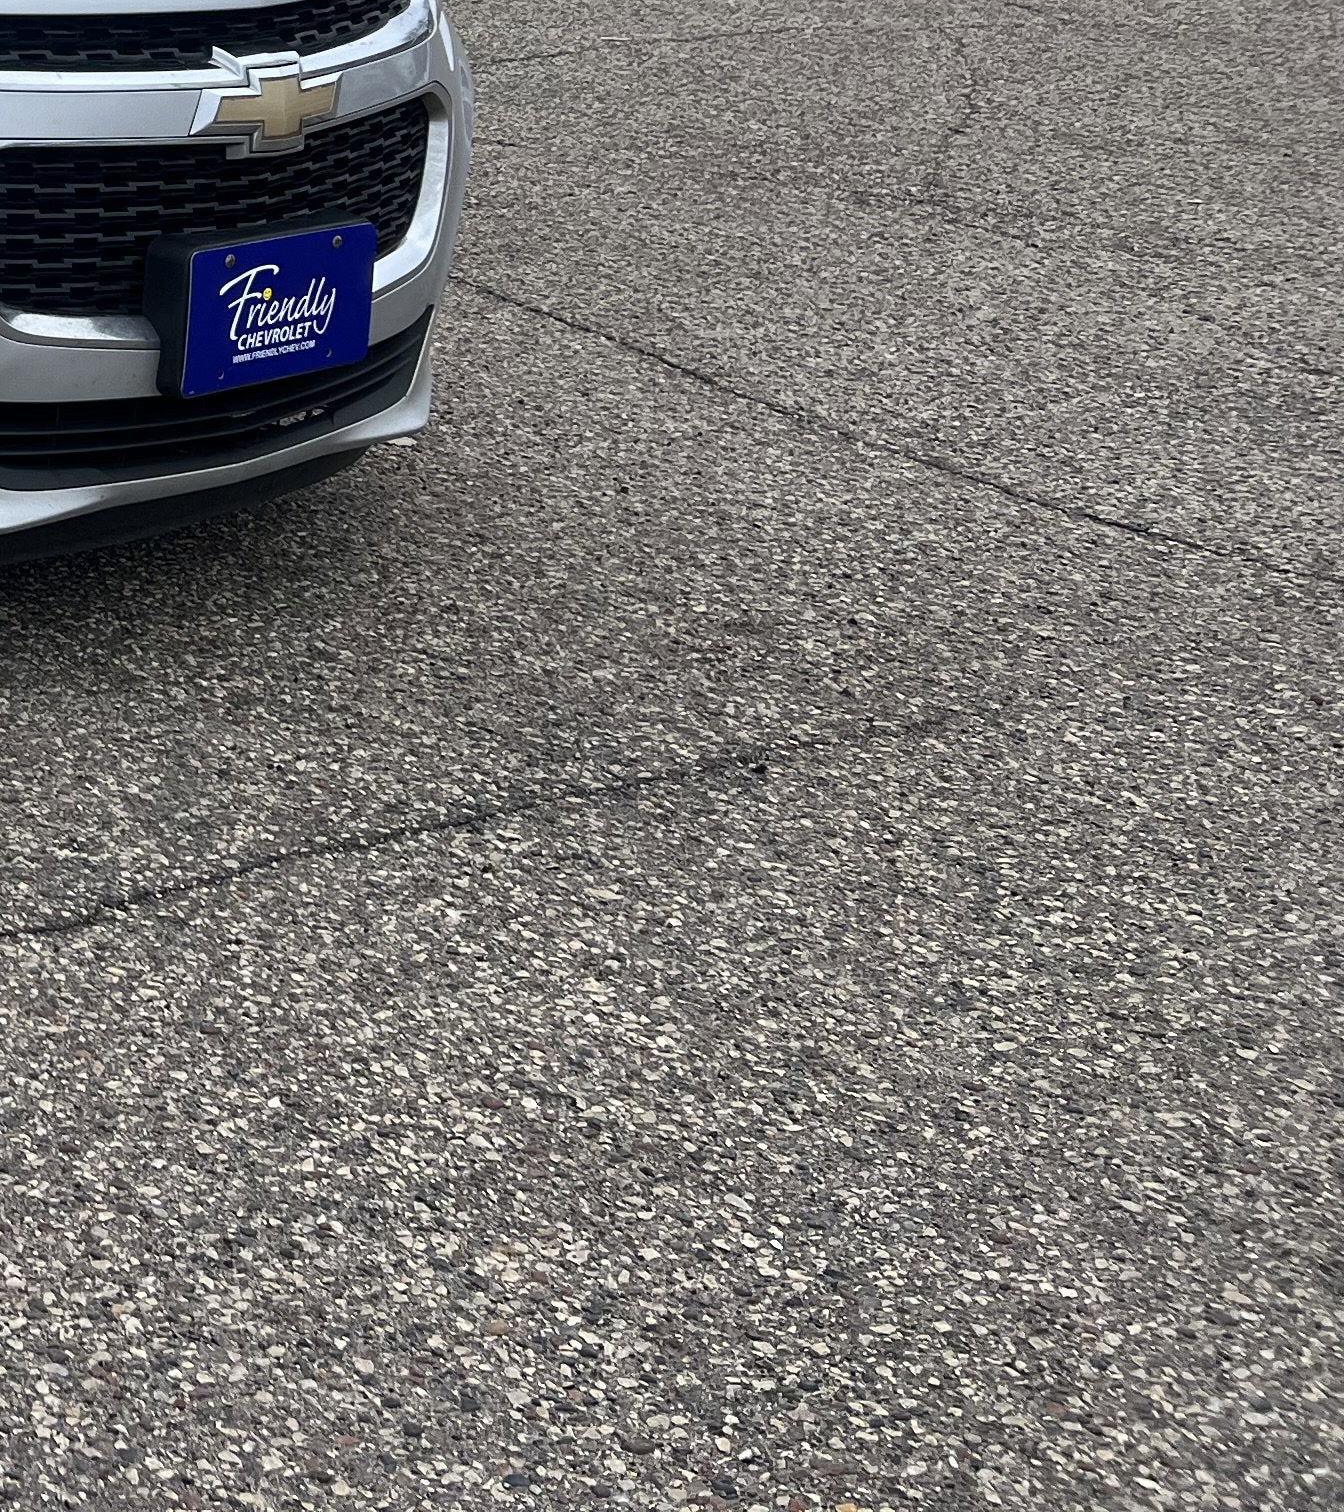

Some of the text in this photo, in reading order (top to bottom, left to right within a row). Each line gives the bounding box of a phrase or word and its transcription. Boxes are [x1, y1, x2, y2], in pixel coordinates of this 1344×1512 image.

[219, 264, 336, 340] Friendly
[237, 321, 312, 350] CHEVROLET
[232, 339, 316, 364] WWW.FRIENDLYCHEV.COM
